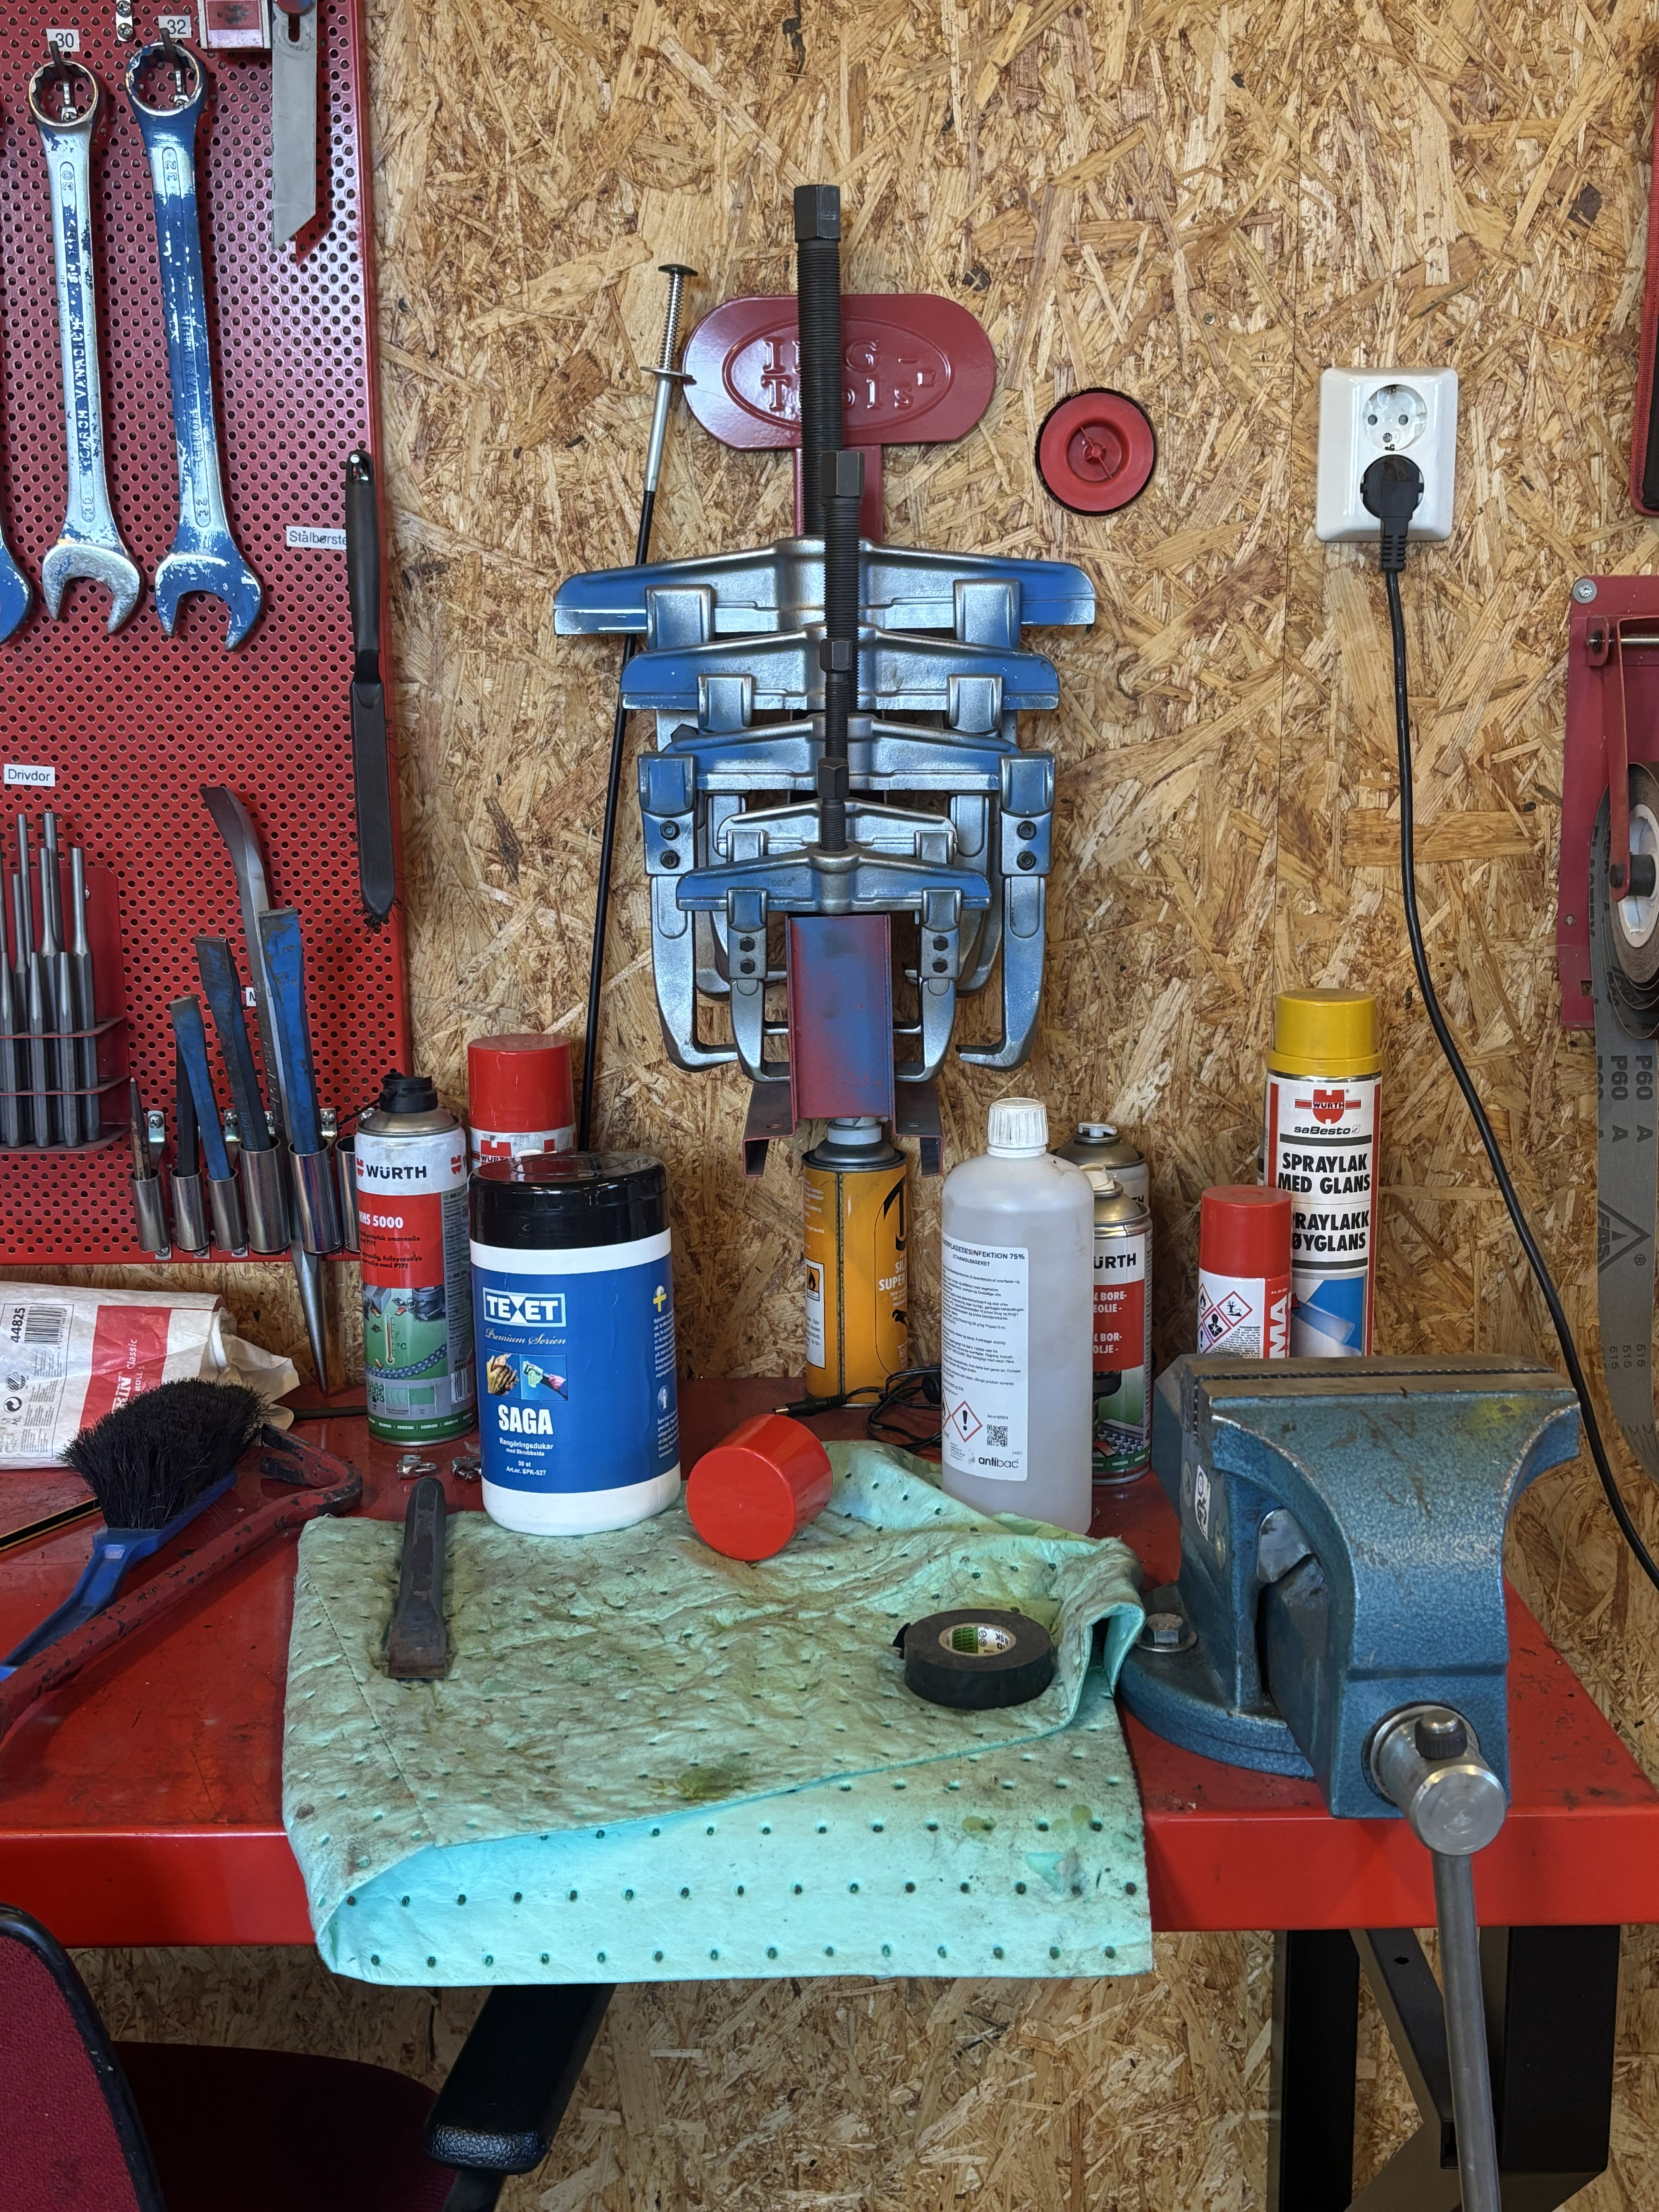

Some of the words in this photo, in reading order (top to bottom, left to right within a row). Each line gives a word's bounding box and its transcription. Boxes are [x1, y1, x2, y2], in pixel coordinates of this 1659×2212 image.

[167, 19, 187, 34] 32
[55, 33, 74, 48] 30
[9, 768, 51, 781] Drivdor
[1611, 1056, 1628, 1101] P60
[1635, 1056, 1653, 1101] P60
[1294, 1126, 1351, 1135] saBesto
[1612, 1124, 1629, 1143] A
[1637, 1124, 1653, 1143] A
[1283, 1152, 1368, 1173] SPRAYLAK
[366, 1165, 427, 1180] WÜRTH
[1278, 1172, 1312, 1193] MED
[1320, 1174, 1370, 1194] GLANS
[373, 1215, 404, 1229] 5000
[1293, 1210, 1369, 1231] RAYLAKK
[1101, 1291, 1127, 1301] BORE-
[486, 1295, 558, 1323] TEXET
[10, 1308, 25, 1343] 44825
[485, 1328, 526, 1344] Premium
[528, 1333, 567, 1345] Serien
[1101, 1333, 1122, 1341] BOR-
[127, 1338, 138, 1369] Classic
[498, 1404, 553, 1435] SAGA
[499, 1437, 554, 1450] Rengöringsdukar
[978, 1456, 1019, 1468] antibac
